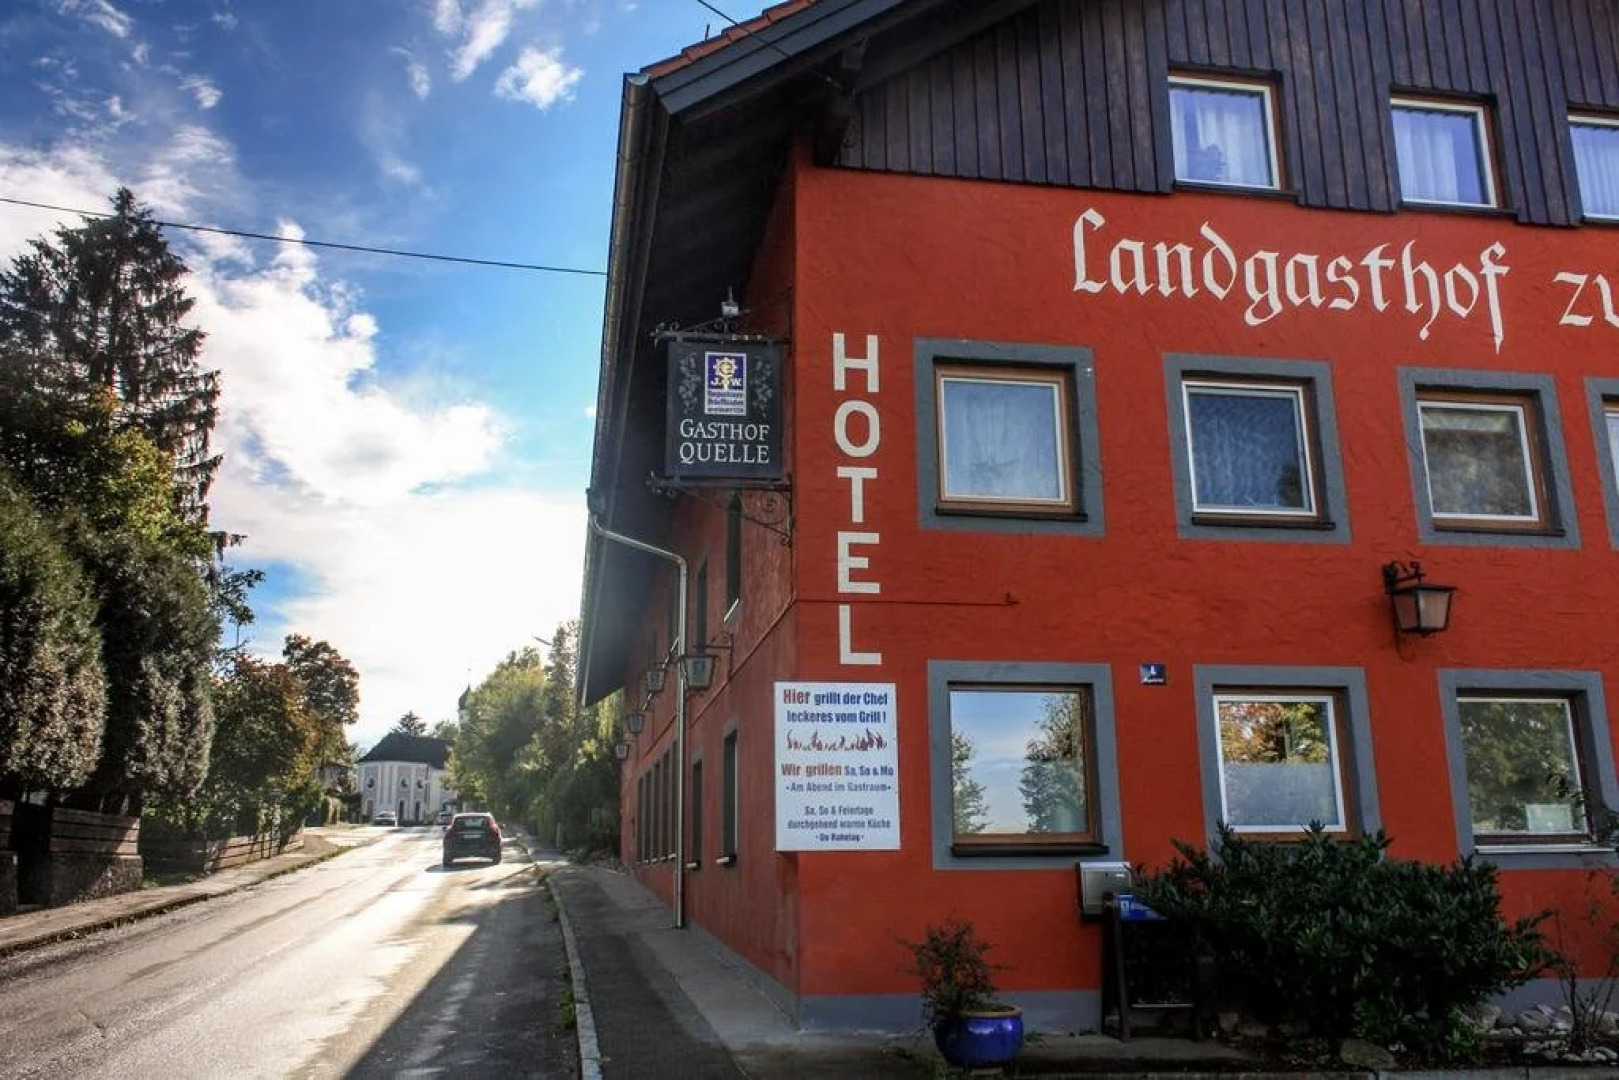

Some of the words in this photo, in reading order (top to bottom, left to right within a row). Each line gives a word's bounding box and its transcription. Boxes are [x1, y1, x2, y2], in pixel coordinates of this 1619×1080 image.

[1072, 208, 1509, 354] Landgasthof
[679, 418, 771, 441] GASTHOF
[679, 442, 771, 465] QUELLE
[832, 332, 882, 665] HOTEL
[783, 689, 811, 705] Hier
[814, 692, 841, 706] grillt
[843, 692, 861, 705] der
[863, 692, 888, 705] Chef
[786, 710, 834, 723] leckeres
[835, 711, 858, 723] vom
[781, 763, 800, 776] Wir
[805, 763, 842, 777] grillen
[859, 765, 870, 776] So
[806, 782, 833, 792] Abend
[834, 783, 846, 792] im
